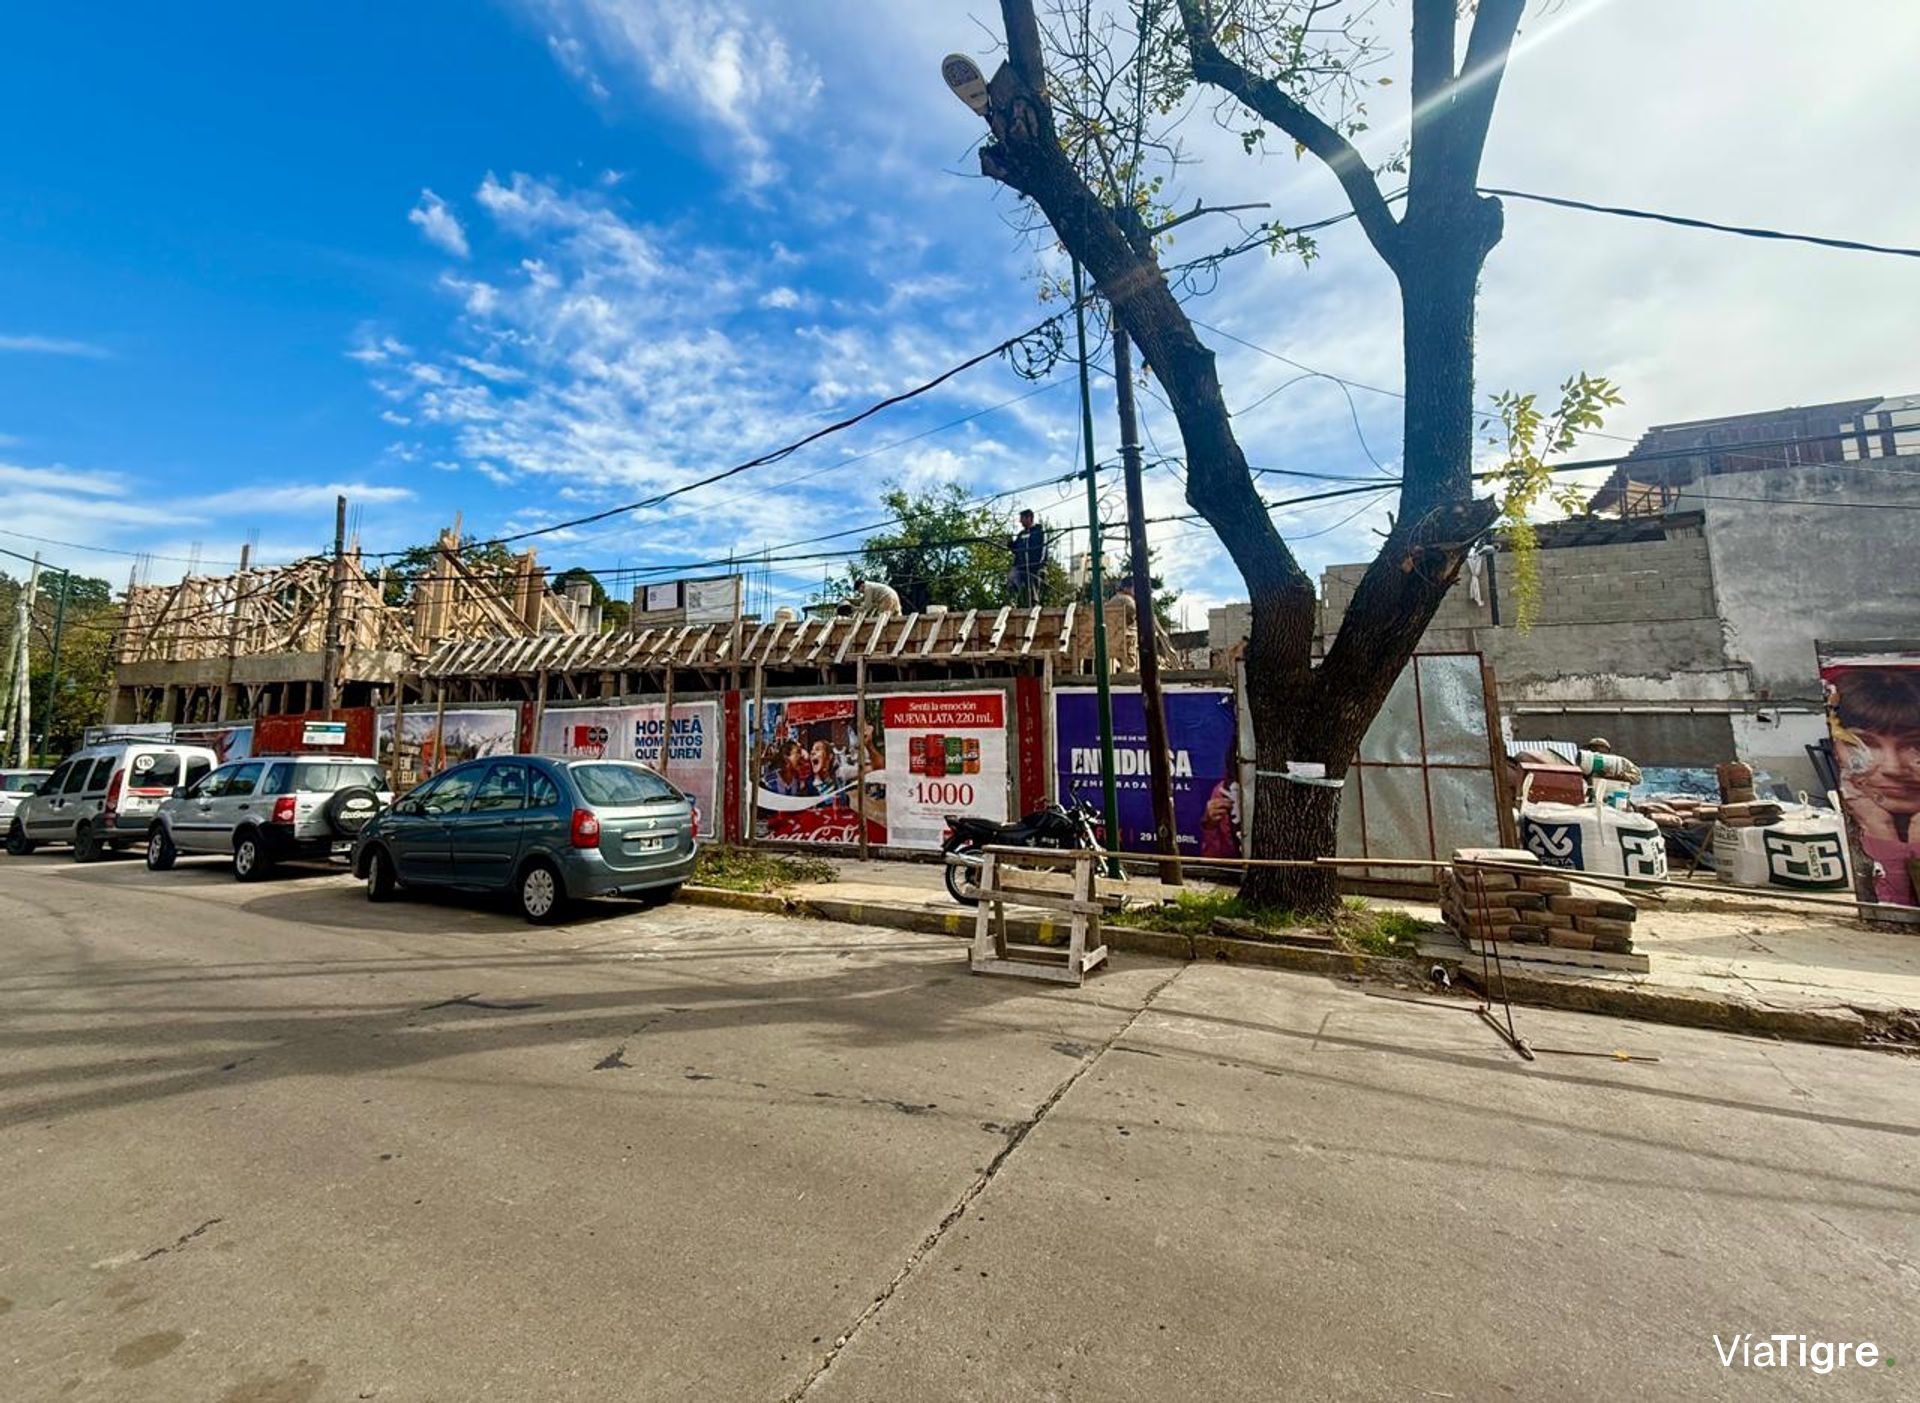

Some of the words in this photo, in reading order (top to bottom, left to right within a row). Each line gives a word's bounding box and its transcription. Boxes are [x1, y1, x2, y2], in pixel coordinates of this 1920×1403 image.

[941, 701, 977, 711] emoción
[894, 713, 927, 725] NUEVA
[928, 713, 955, 724] LATA
[956, 713, 975, 723] 220
[635, 735, 703, 747] MOMNTOS
[635, 749, 659, 759] QUE
[668, 748, 702, 759] UREN
[1071, 748, 1192, 777] ENIDISA
[916, 782, 974, 806] 1.000
[1140, 832, 1151, 841] 29
[1176, 834, 1199, 844] BRIL
[1767, 837, 1844, 882] 26
